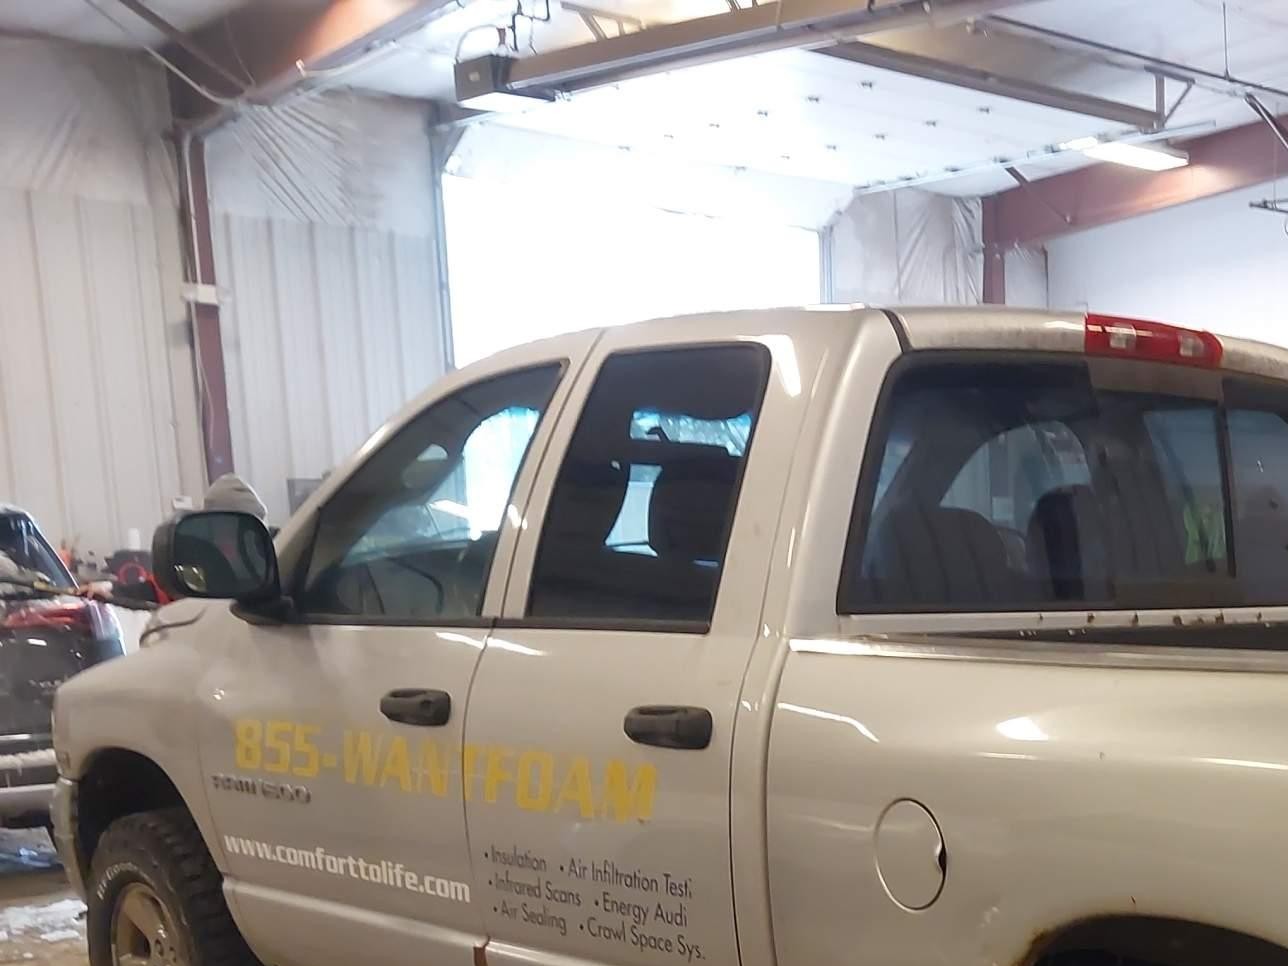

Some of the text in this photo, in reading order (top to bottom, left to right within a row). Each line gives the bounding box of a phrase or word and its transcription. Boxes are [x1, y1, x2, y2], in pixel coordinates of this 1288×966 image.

[234, 719, 657, 823] 855-WANTFOAM
[224, 834, 470, 903] www.comforttolife.com
[491, 845, 547, 873] Insulation
[567, 857, 588, 882] Air
[591, 860, 659, 893] Infiltration
[494, 870, 542, 900] Infrared
[545, 881, 582, 907] Scans
[602, 891, 650, 926] Energy
[500, 900, 519, 918] Air
[522, 903, 568, 937] Sealing
[586, 916, 628, 942] Crawl
[631, 924, 674, 953] Space
